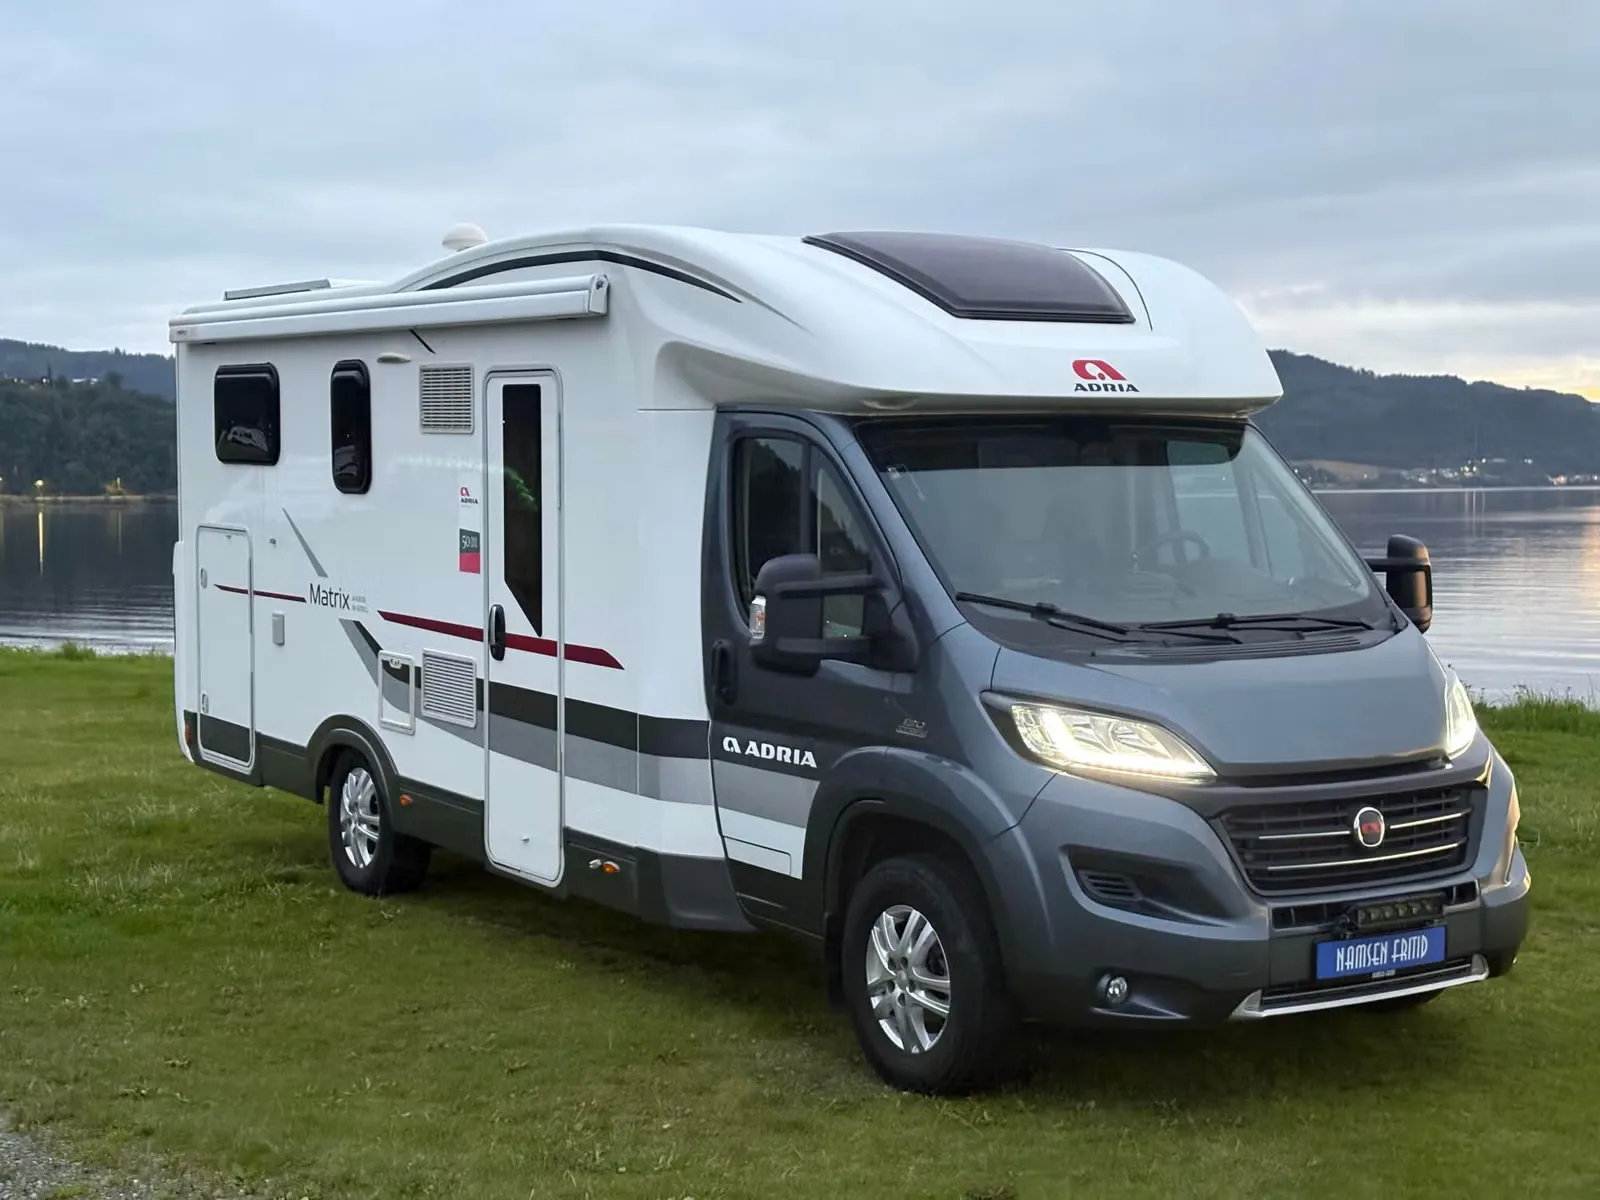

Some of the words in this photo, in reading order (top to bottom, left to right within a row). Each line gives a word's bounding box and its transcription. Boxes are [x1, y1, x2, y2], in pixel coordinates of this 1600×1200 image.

[1074, 383, 1140, 392] ADRIA
[309, 583, 350, 610] Matrix
[745, 740, 817, 768] ADRIA
[1336, 941, 1388, 972] NAMSEN
[1391, 935, 1428, 963] FRITID
